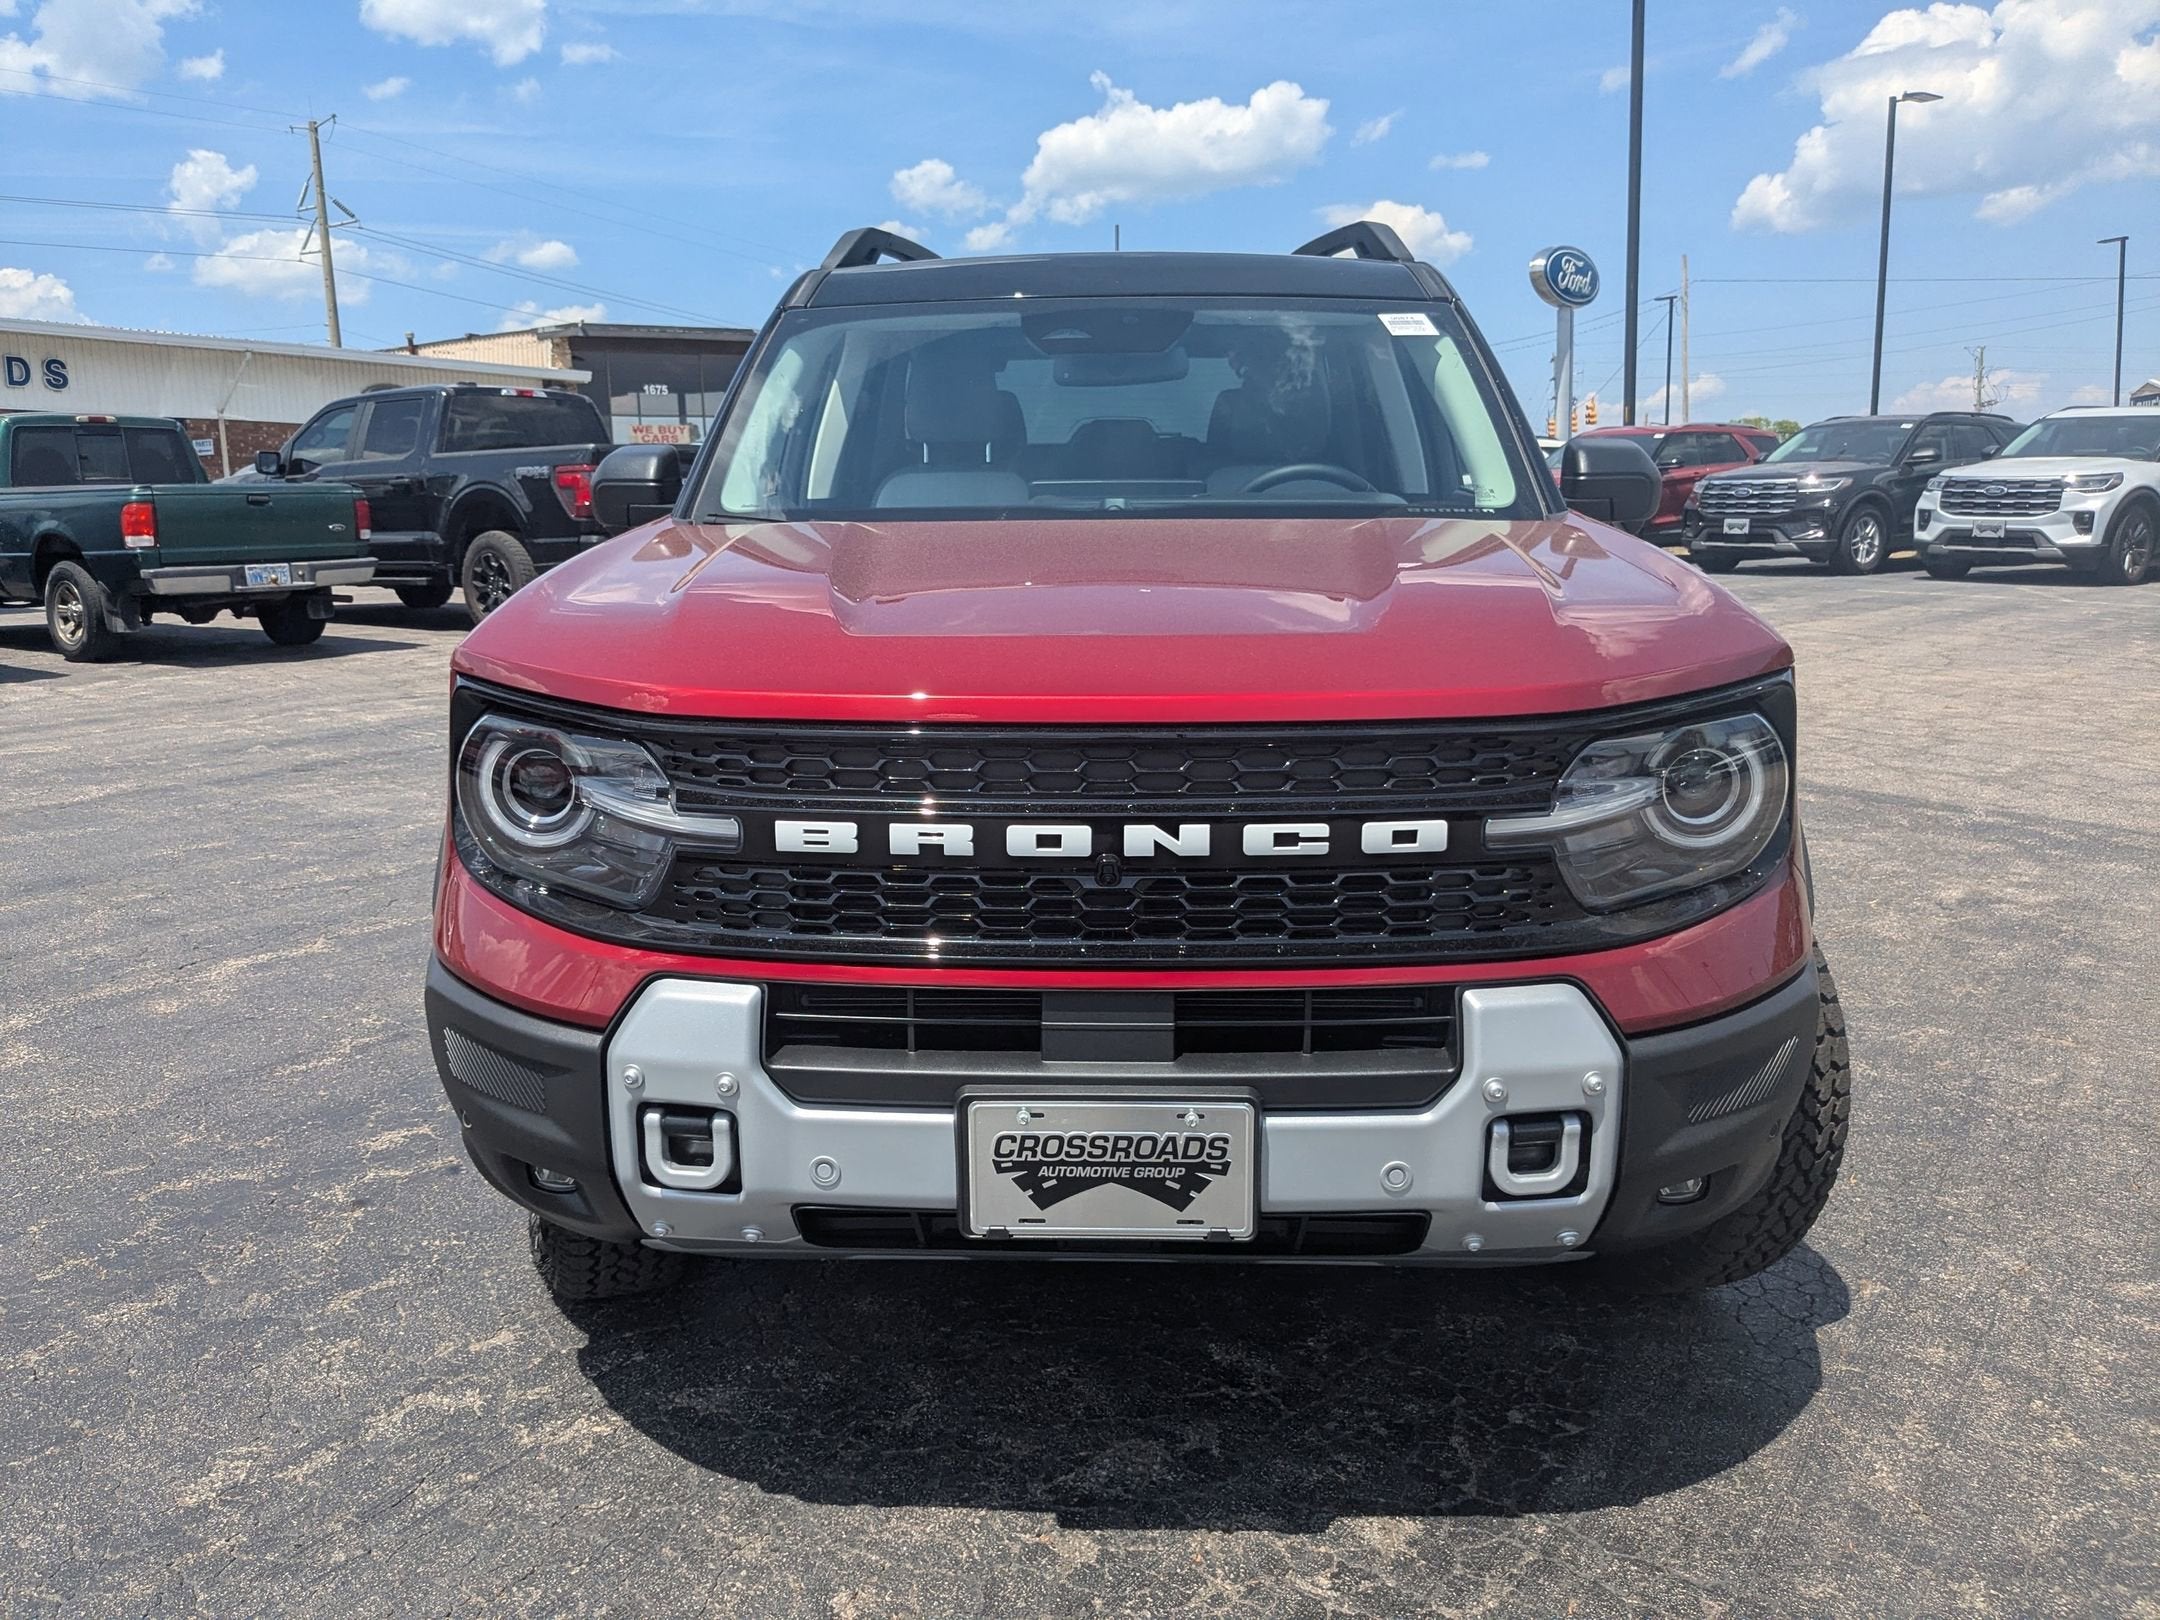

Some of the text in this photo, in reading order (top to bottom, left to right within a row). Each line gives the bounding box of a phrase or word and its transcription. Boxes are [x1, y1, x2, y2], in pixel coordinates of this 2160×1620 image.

[1558, 256, 1592, 294] Ford
[643, 384, 669, 396] 1675
[632, 425, 686, 434] WE BUY
[641, 434, 679, 443] CARS
[775, 819, 1448, 857] BRONCO
[993, 1134, 1230, 1161] CROSSROADS
[1037, 1165, 1186, 1179] AUTOMOTIVE GROUP
